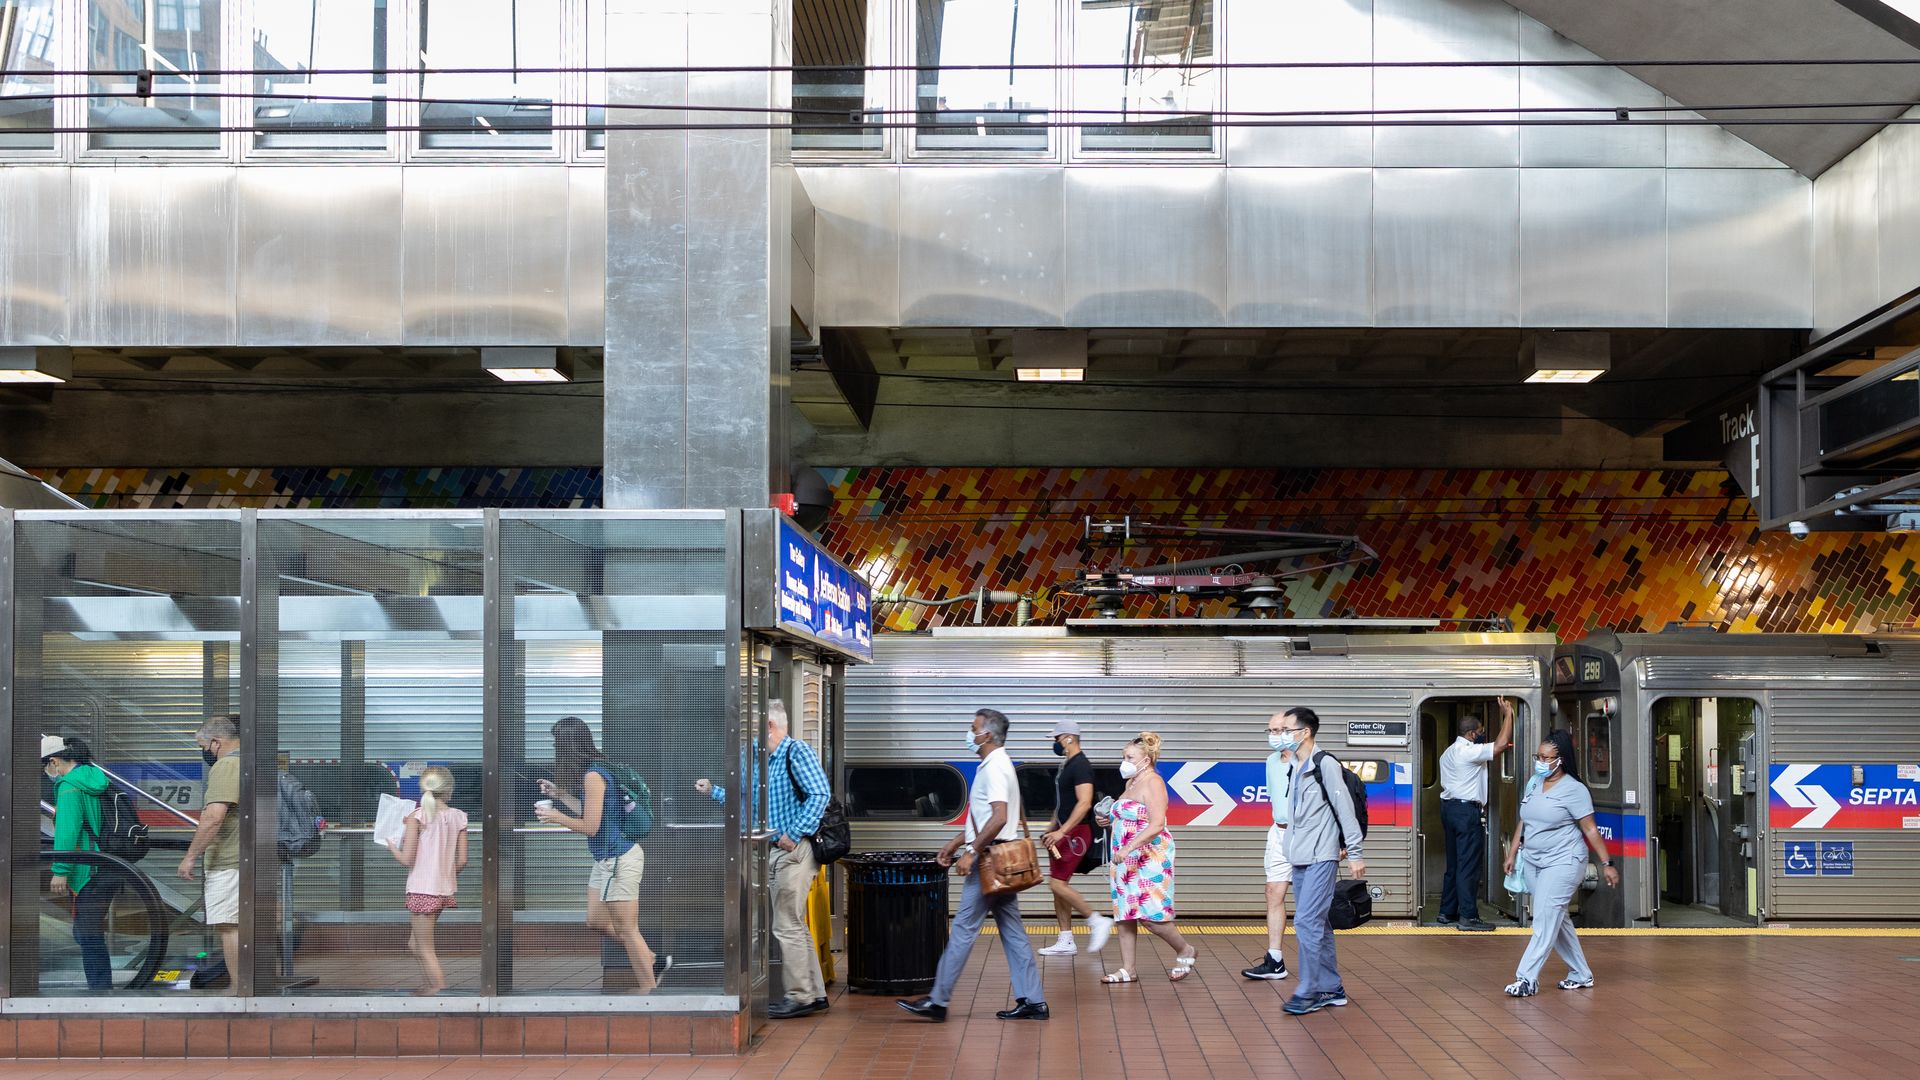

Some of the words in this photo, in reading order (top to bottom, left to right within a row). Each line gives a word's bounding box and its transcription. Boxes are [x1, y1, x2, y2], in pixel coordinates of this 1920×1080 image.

[1720, 403, 1754, 444] Track
[1750, 434, 1760, 498] E
[820, 569, 838, 606] Jefferson
[1584, 661, 1601, 680] 298
[1349, 722, 1371, 730] Center
[1372, 722, 1386, 730] City
[1341, 761, 1378, 781] 76
[1849, 788, 1917, 805] SEPTA
